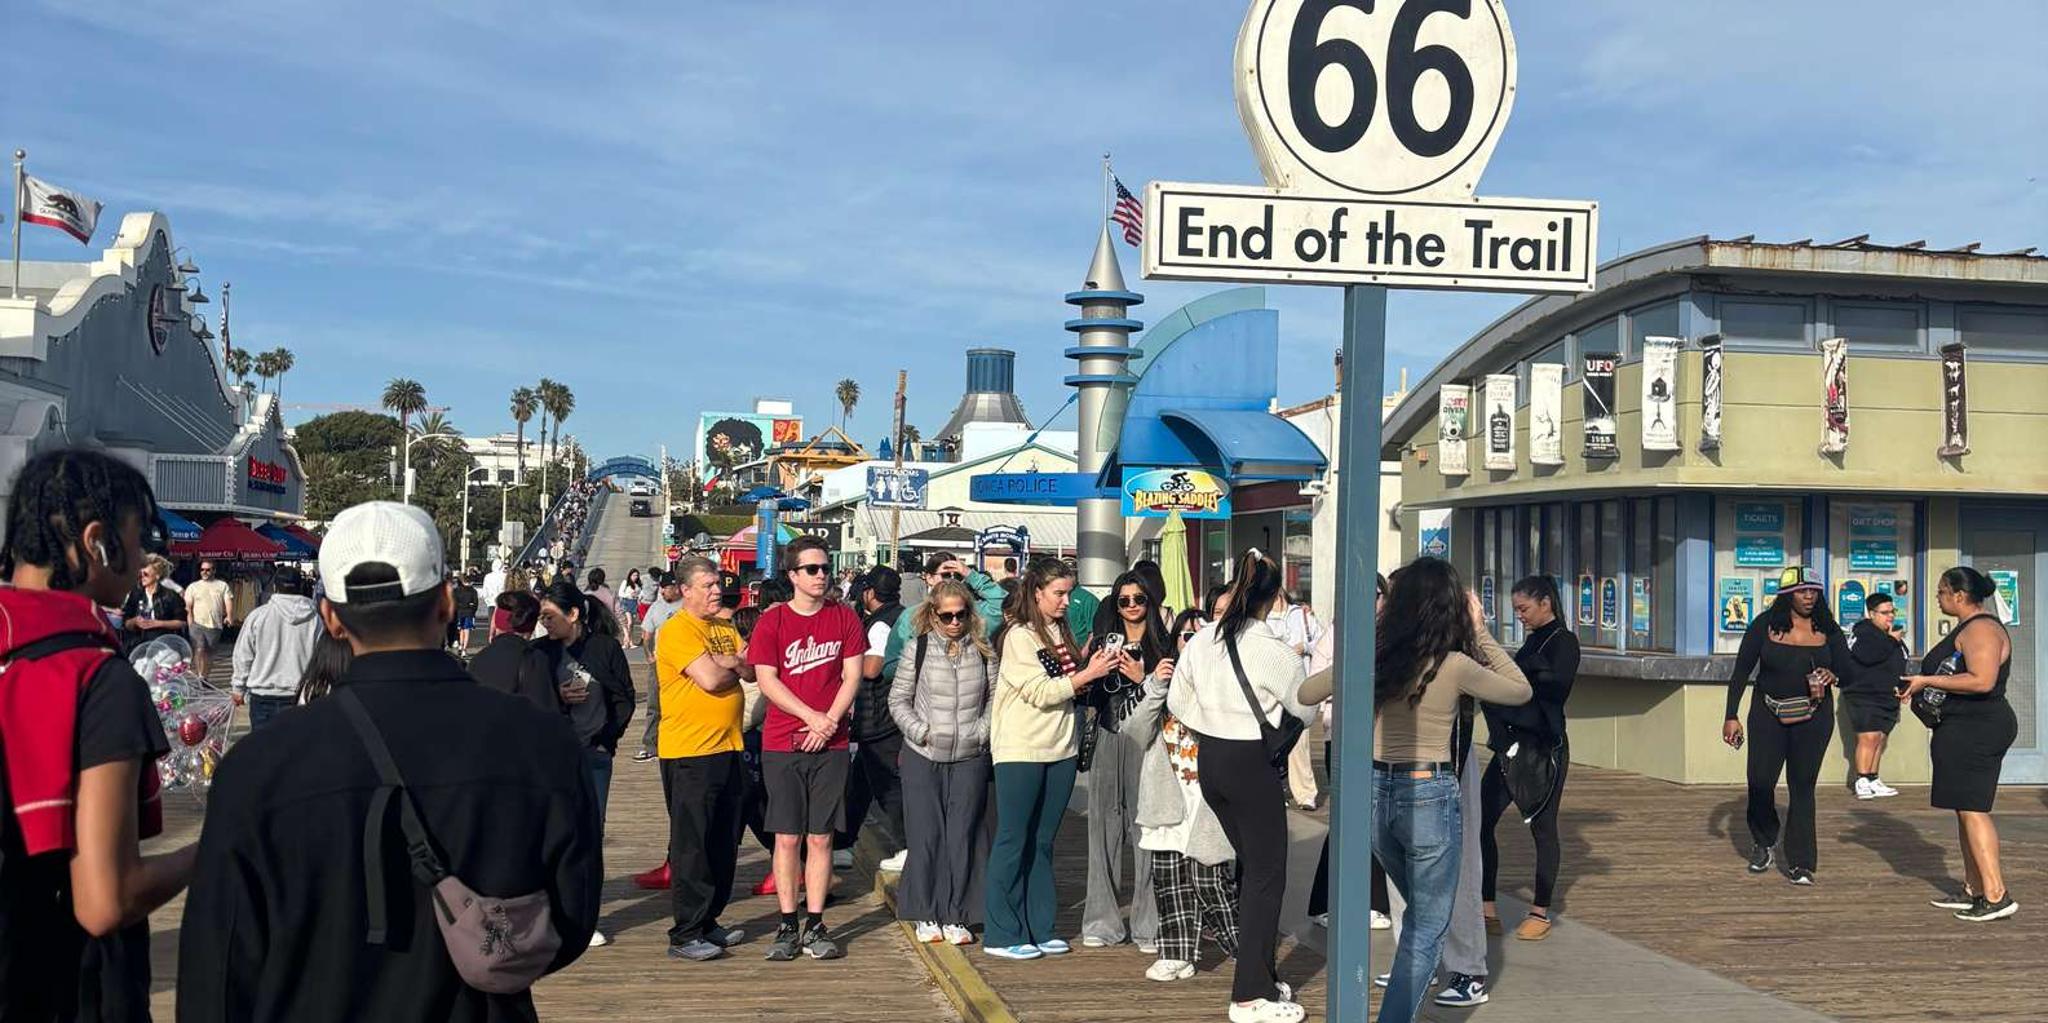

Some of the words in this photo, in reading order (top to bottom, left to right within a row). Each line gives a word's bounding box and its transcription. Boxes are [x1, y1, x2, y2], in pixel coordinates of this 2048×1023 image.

[1288, 0, 1474, 158] 66
[1177, 205, 1274, 259] End
[1294, 207, 1349, 263] of
[1365, 210, 1446, 266] the
[1464, 216, 1573, 272] Trail
[1586, 359, 1615, 372] UFO
[1007, 478, 1058, 493] POLICE
[1134, 488, 1177, 513] BLAZING
[1177, 490, 1219, 513] SADDLES
[725, 576, 733, 588] P
[784, 635, 842, 674] Indiana
